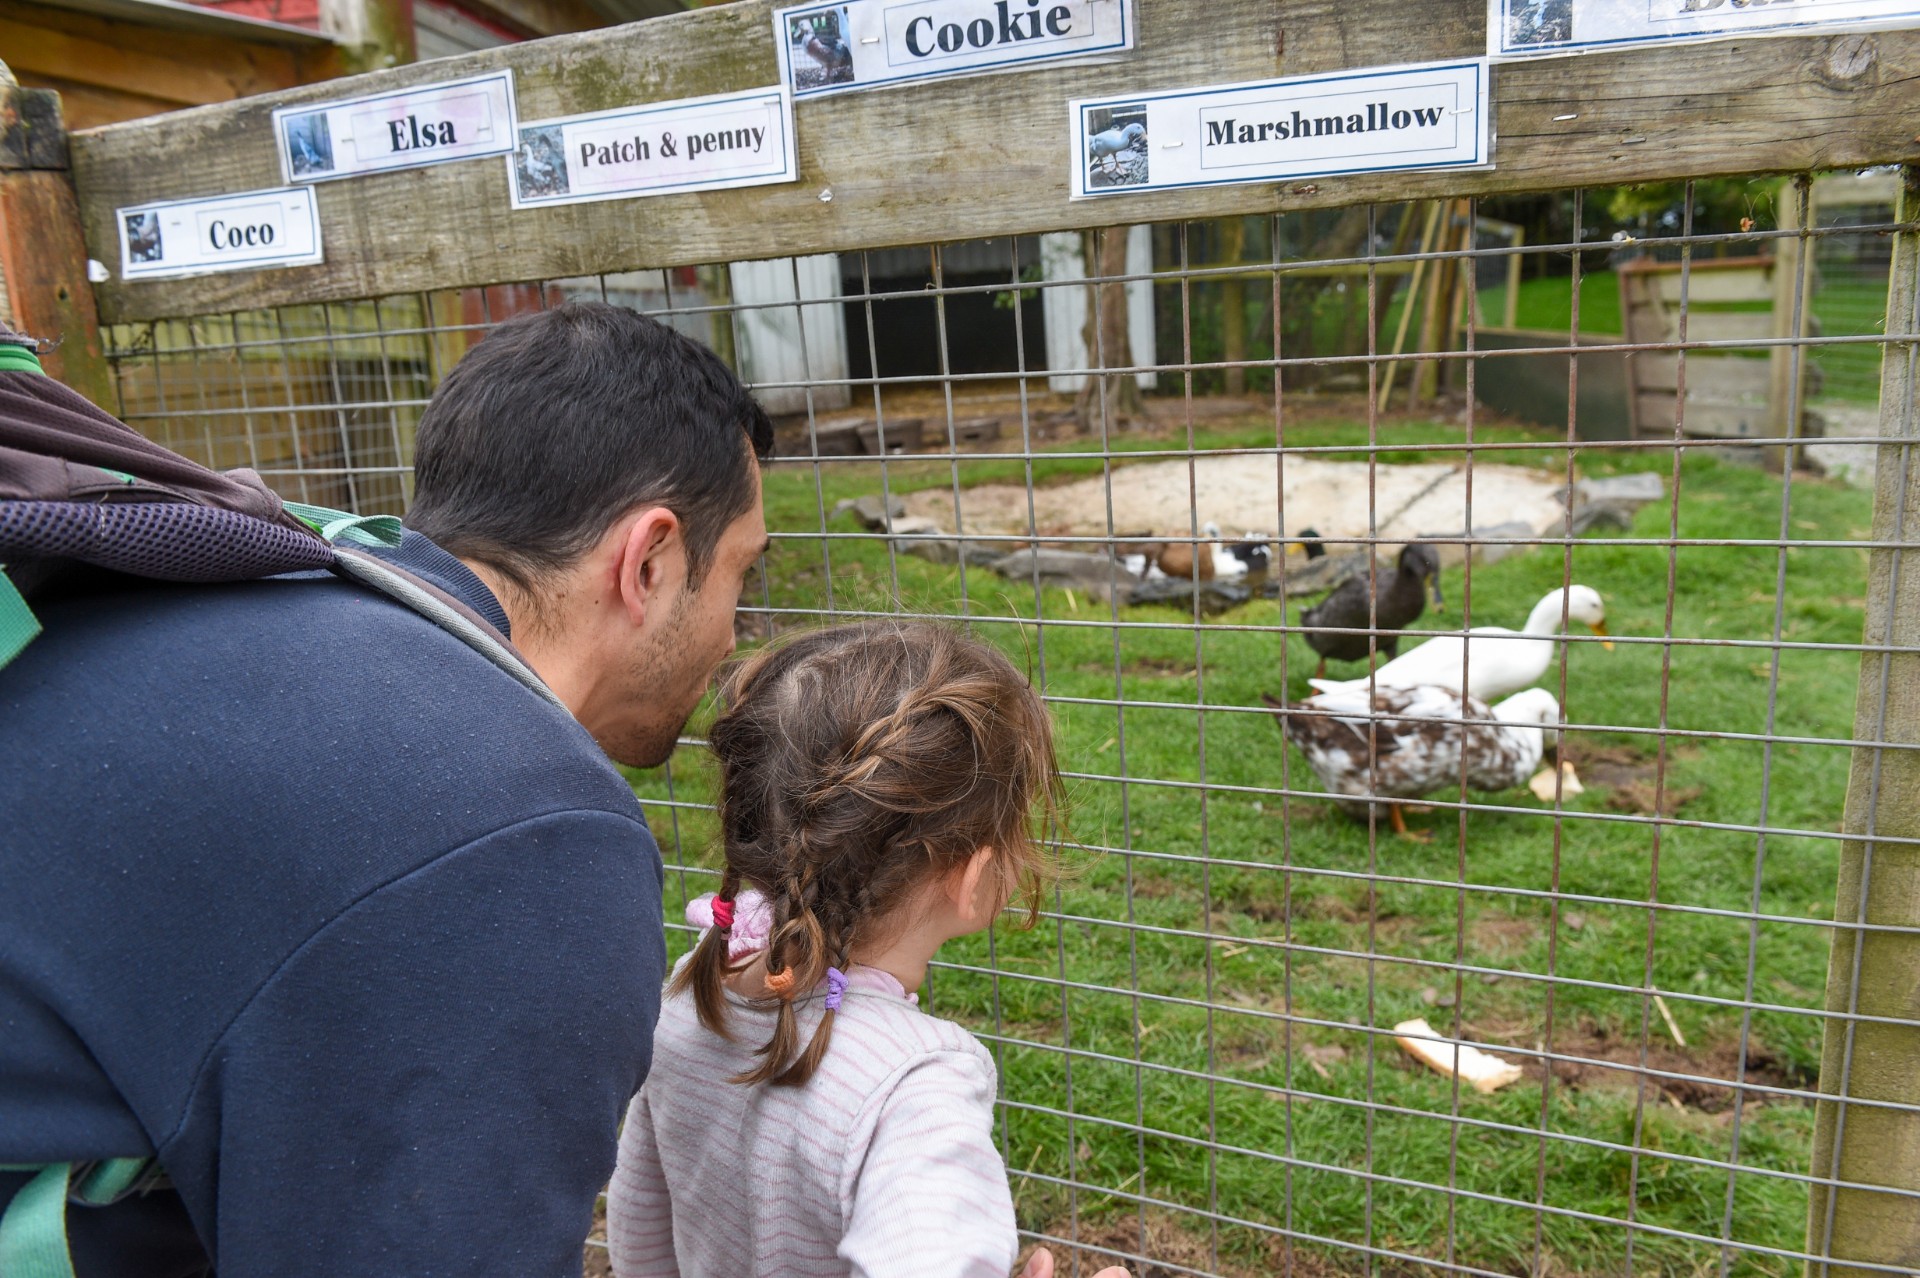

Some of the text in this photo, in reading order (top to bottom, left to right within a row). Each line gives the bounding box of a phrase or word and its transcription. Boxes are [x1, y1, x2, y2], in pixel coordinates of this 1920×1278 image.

[905, 0, 1072, 57] Cookie
[388, 114, 457, 153] Elsa
[582, 124, 766, 167] Patch & penny
[1206, 102, 1445, 147] Marshmallow
[209, 218, 275, 251] Coco
